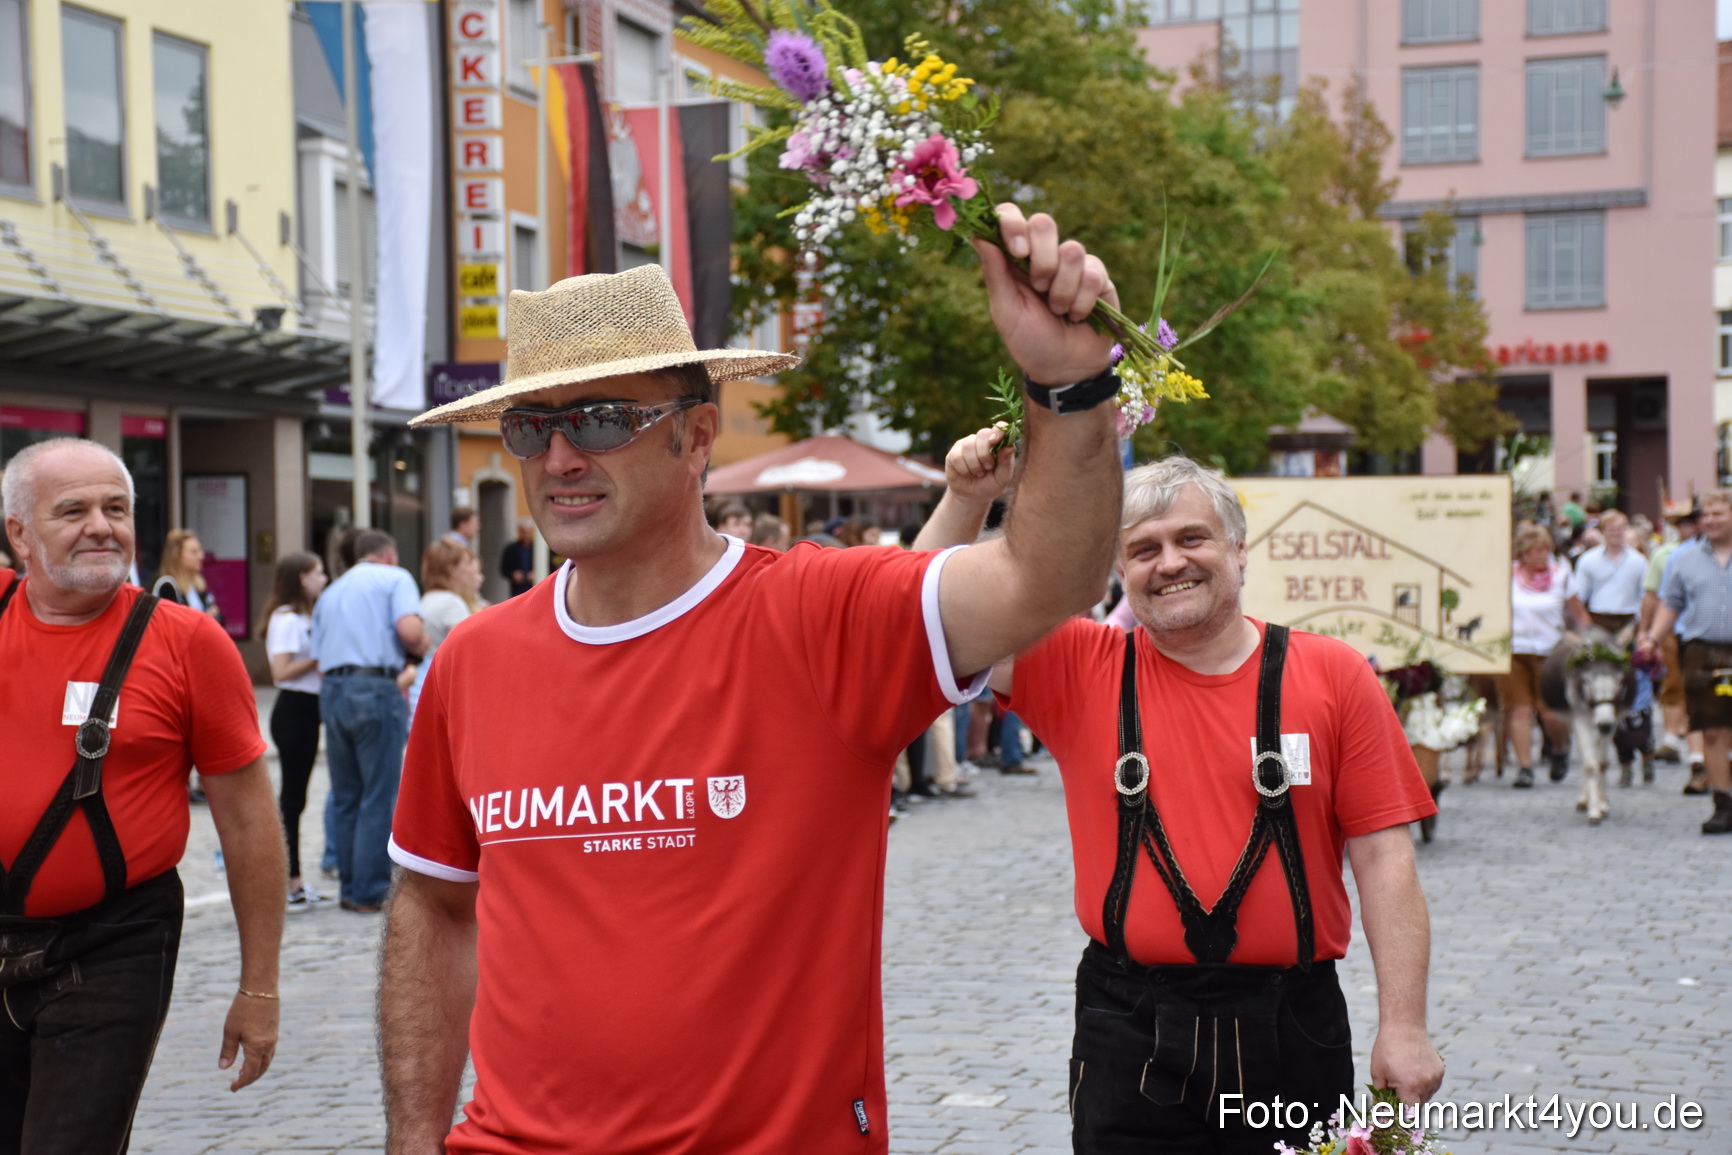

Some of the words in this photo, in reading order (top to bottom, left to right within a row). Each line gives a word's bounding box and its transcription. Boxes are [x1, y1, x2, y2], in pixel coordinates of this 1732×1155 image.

[459, 12, 488, 250] CKEREI
[1486, 337, 1609, 366] arkasse
[1268, 530, 1393, 560] ESELSTALL
[1284, 576, 1369, 601] BEYER
[470, 779, 694, 835] NEUMARKT
[583, 838, 642, 853] STARKE
[647, 834, 696, 849] STADT
